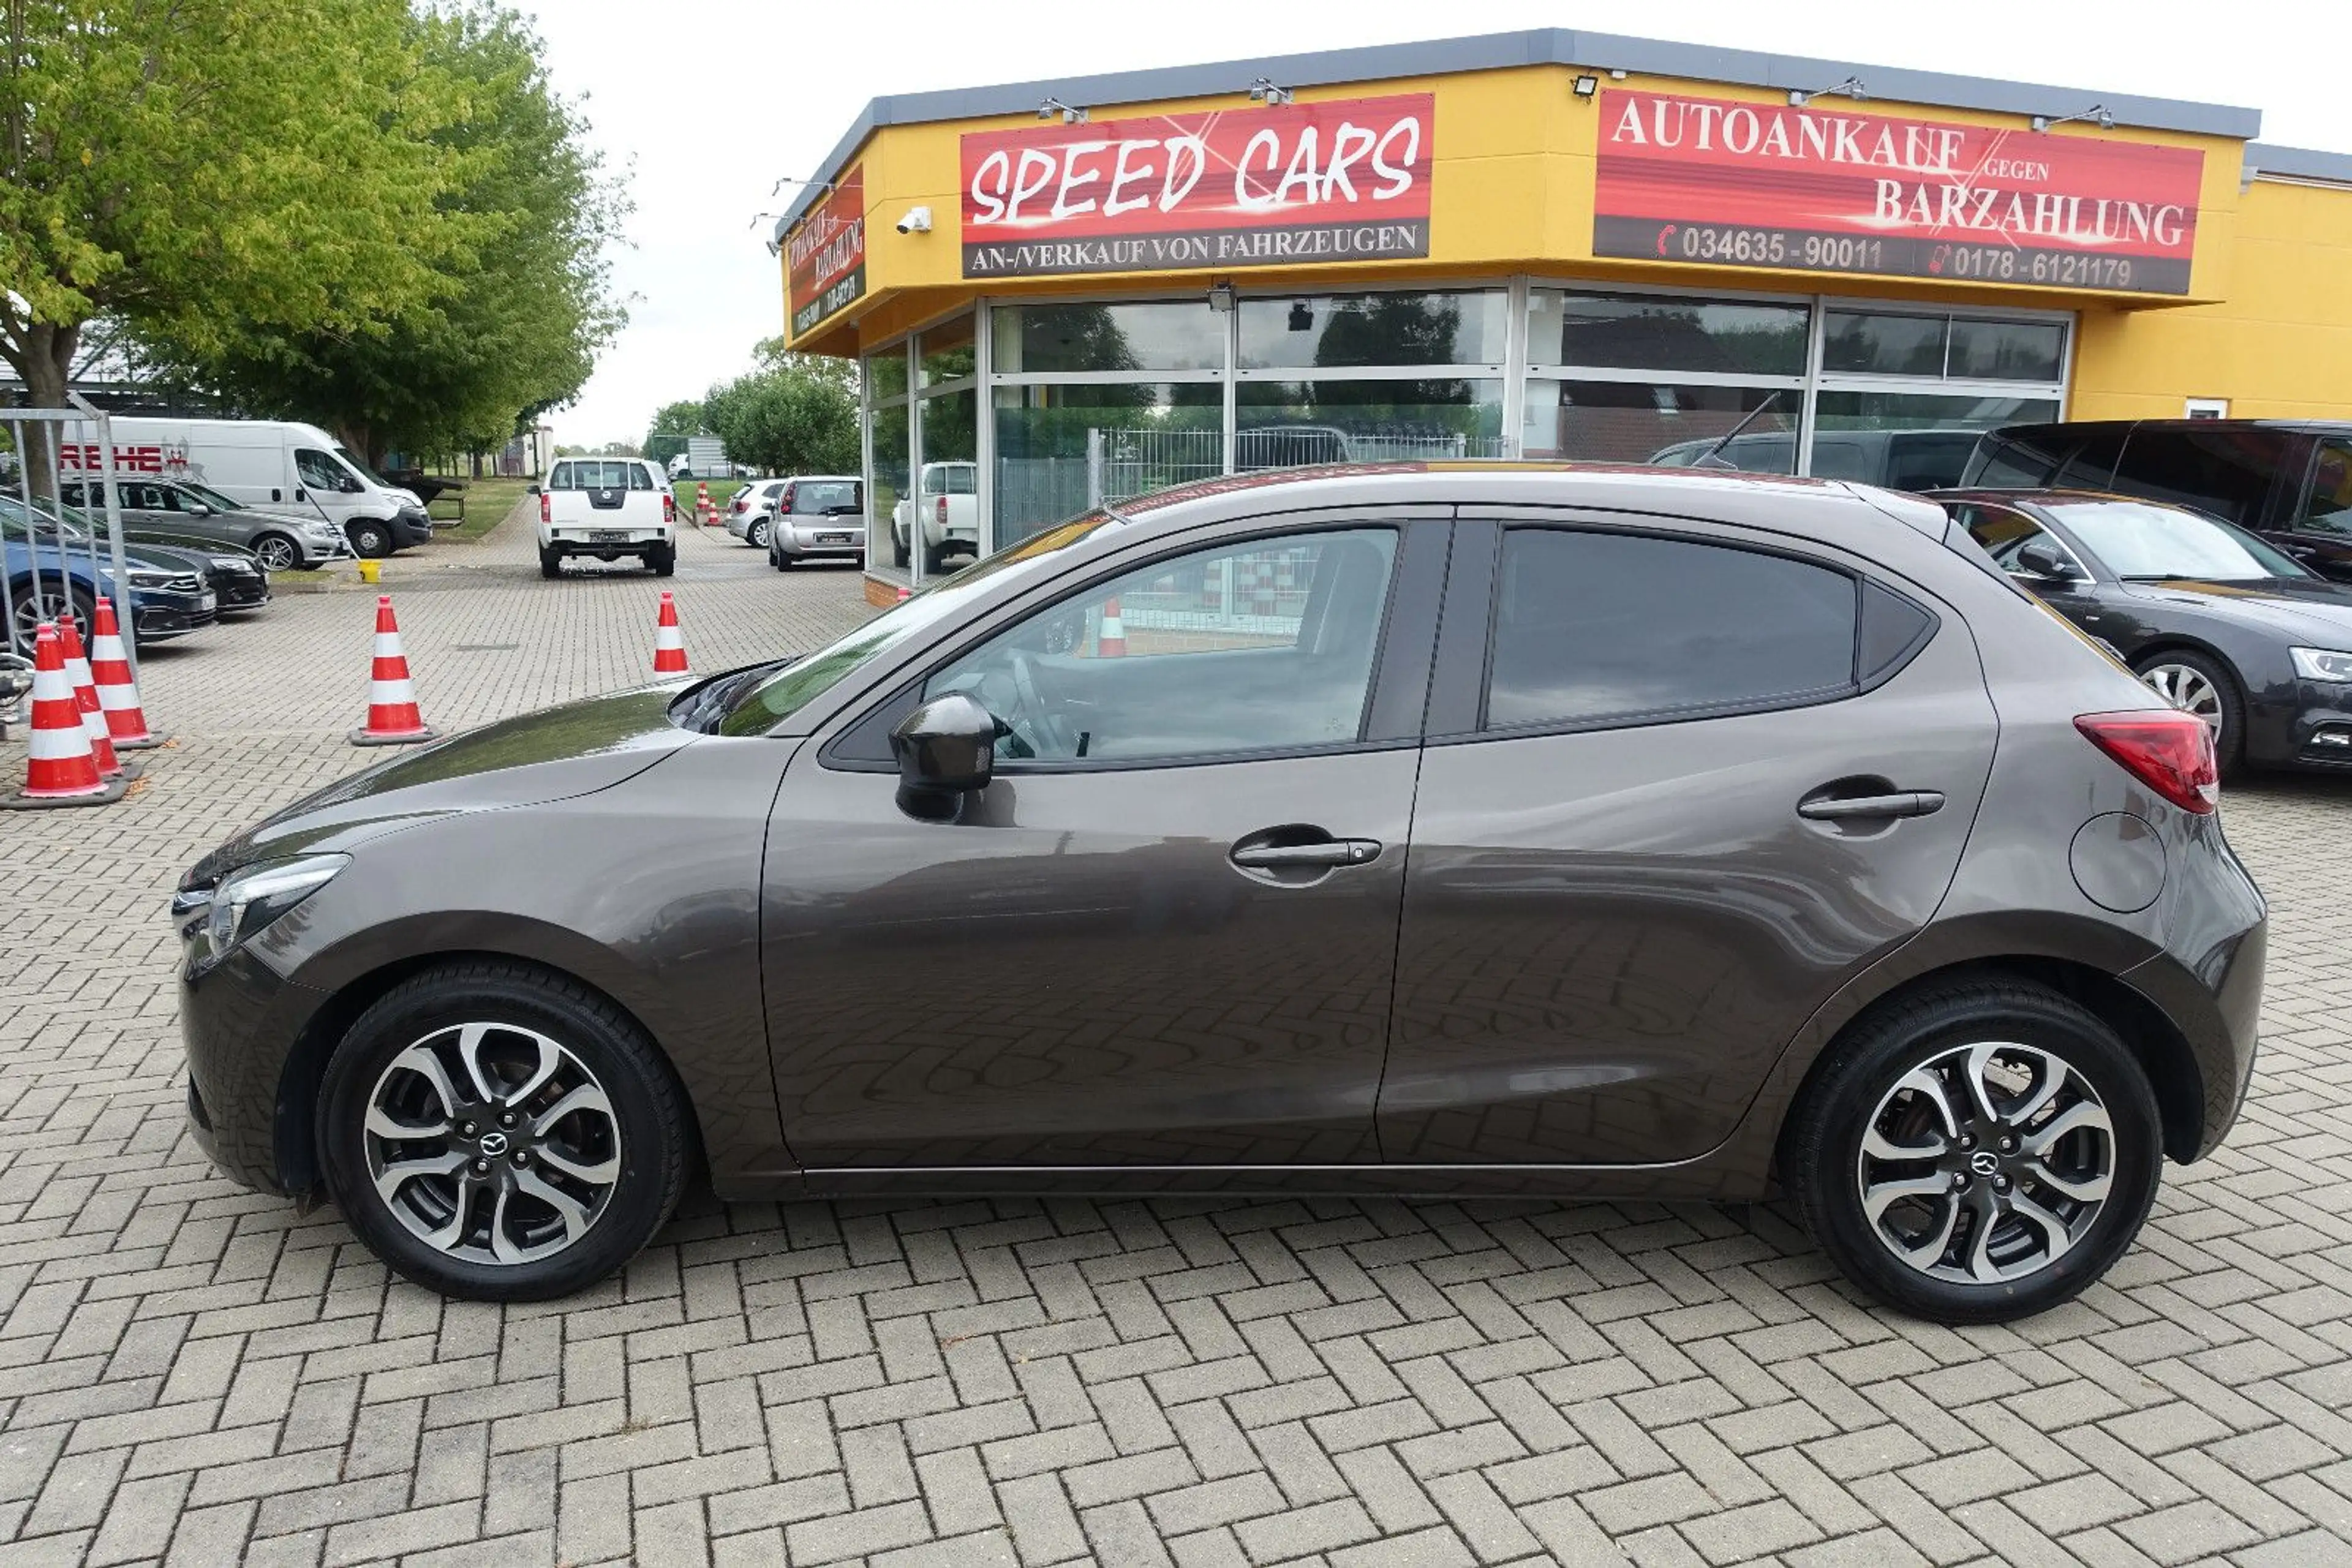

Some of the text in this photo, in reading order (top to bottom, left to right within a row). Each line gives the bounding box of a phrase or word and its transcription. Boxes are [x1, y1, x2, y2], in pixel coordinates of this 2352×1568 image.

[1611, 97, 1965, 173] AUTOANKAUF
[971, 116, 1419, 224] SPEED CARS
[1984, 157, 2049, 182] GEGEN
[1150, 236, 1210, 260] VON
[1217, 225, 1419, 258] FAHRZEUGEN
[1874, 178, 2184, 246] BARZAHLUNG
